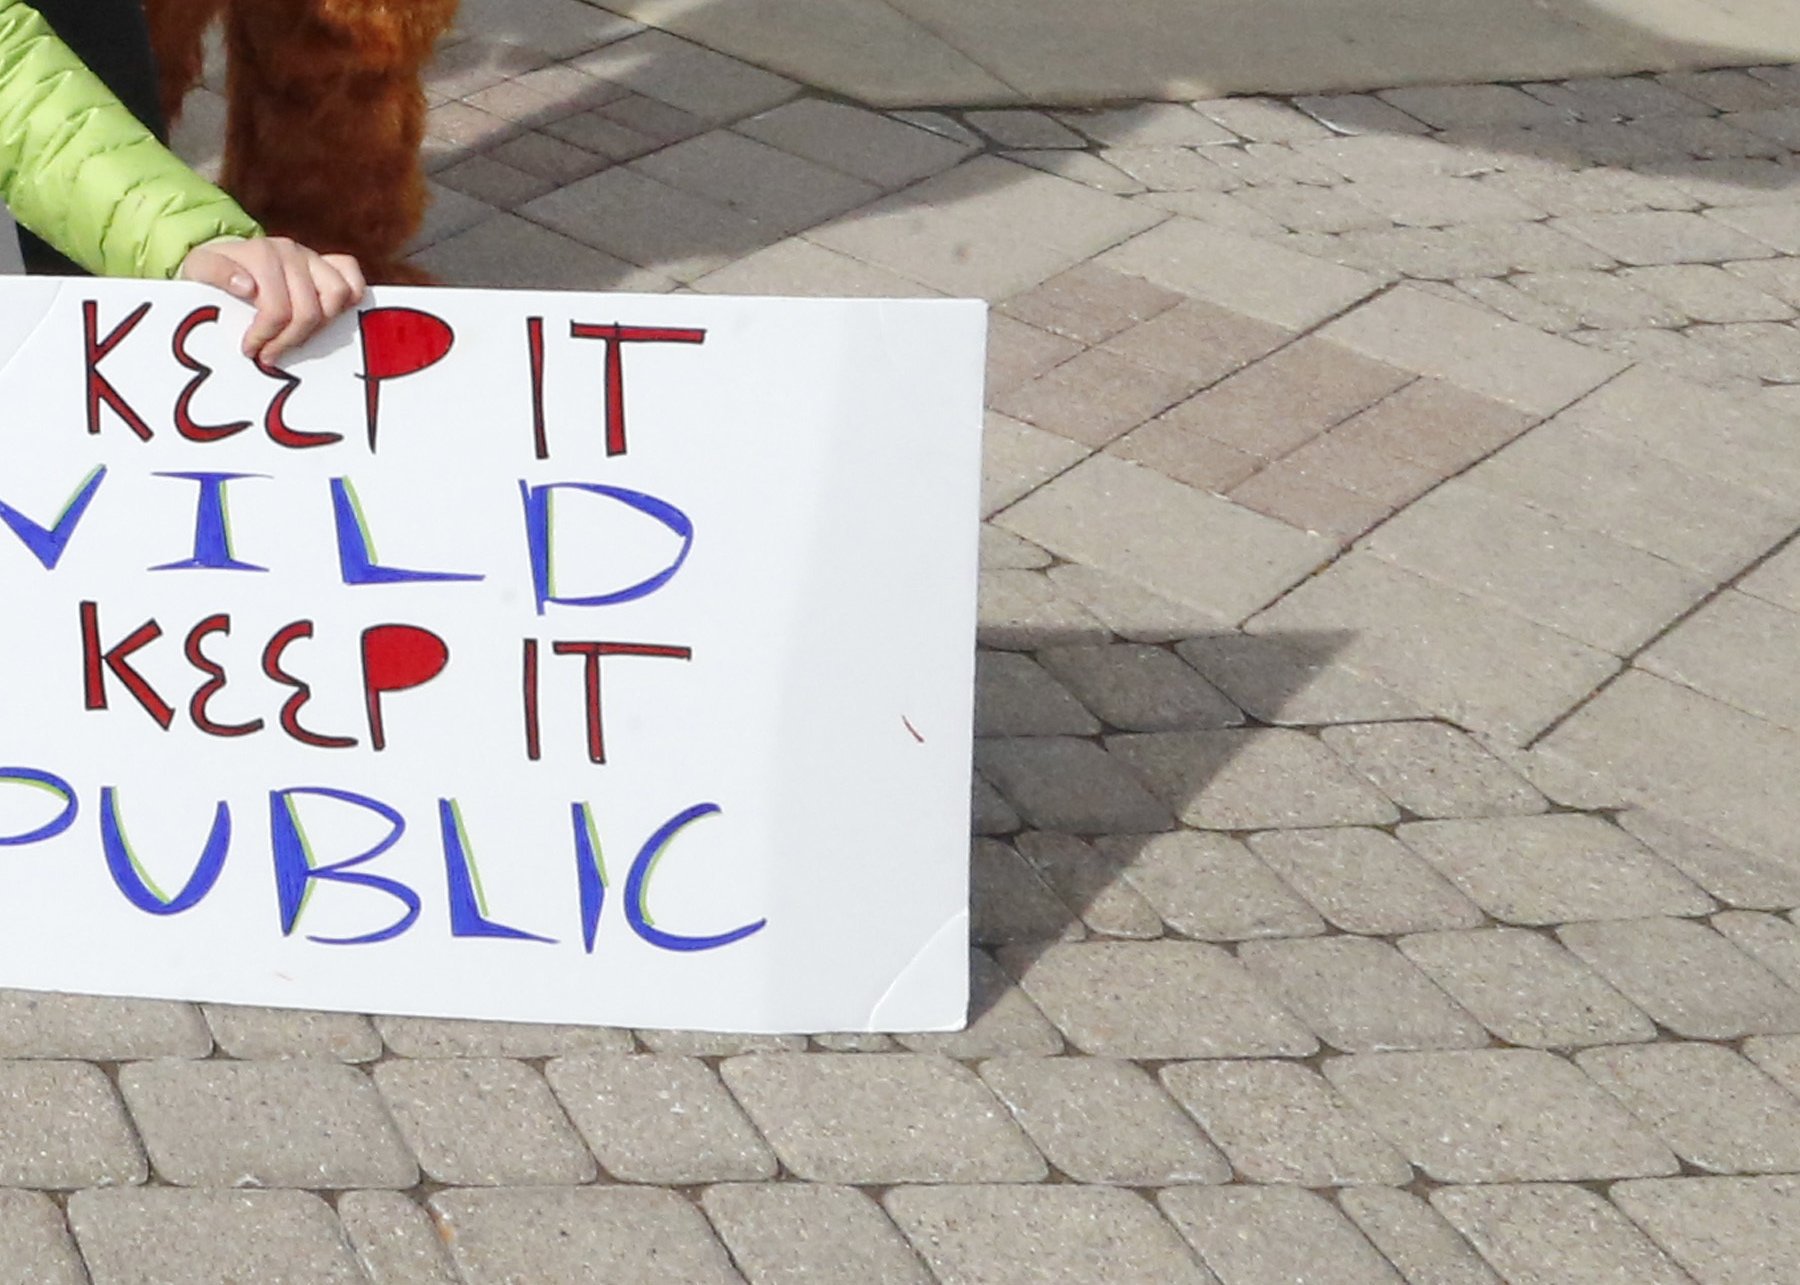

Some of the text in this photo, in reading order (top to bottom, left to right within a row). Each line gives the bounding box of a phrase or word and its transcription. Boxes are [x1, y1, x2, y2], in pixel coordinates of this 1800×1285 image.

[82, 298, 707, 461] KEEP IT
[79, 599, 693, 766] KEEP IT
